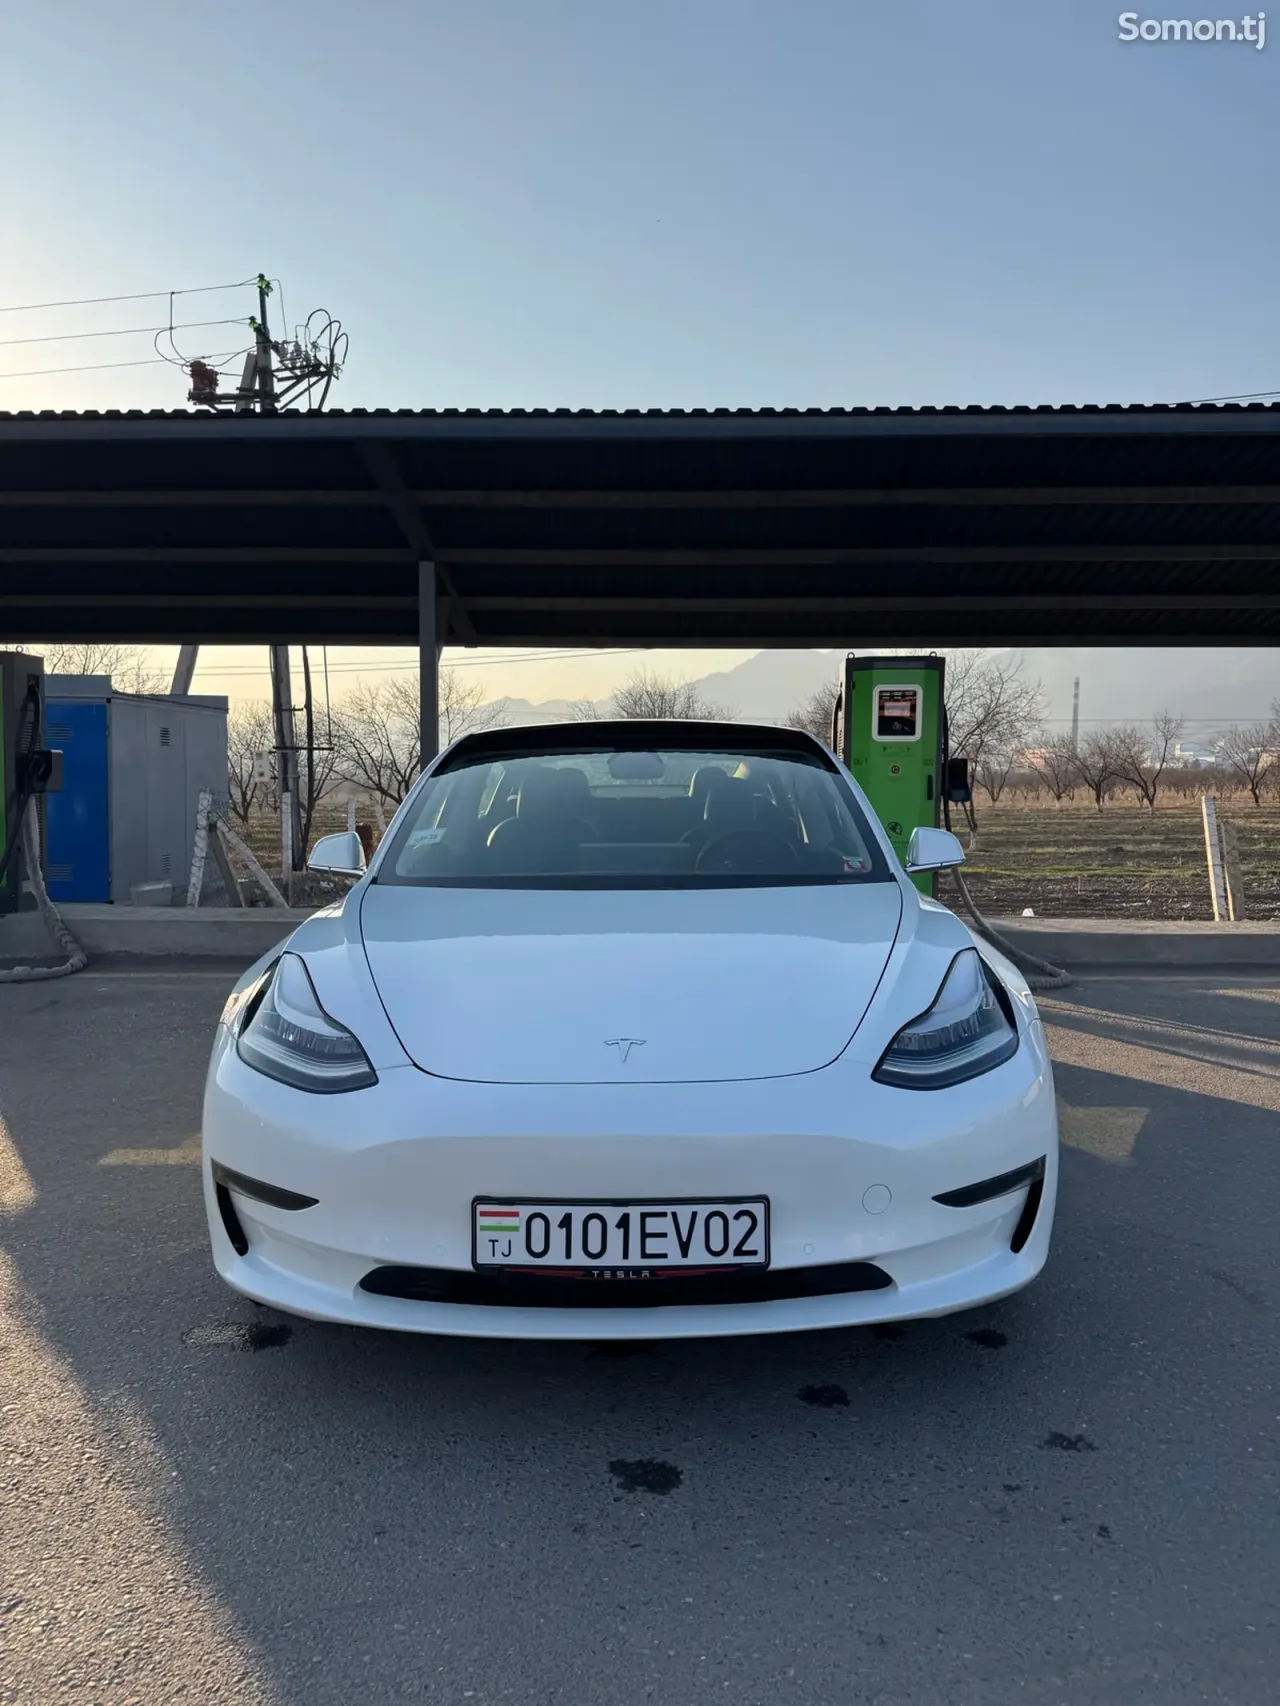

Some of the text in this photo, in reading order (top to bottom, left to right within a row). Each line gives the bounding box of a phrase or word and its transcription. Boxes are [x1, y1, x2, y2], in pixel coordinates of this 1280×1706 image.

[525, 1209, 759, 1260] 0101EV02
[488, 1239, 512, 1258] TJ
[591, 1270, 650, 1279] TESLA
